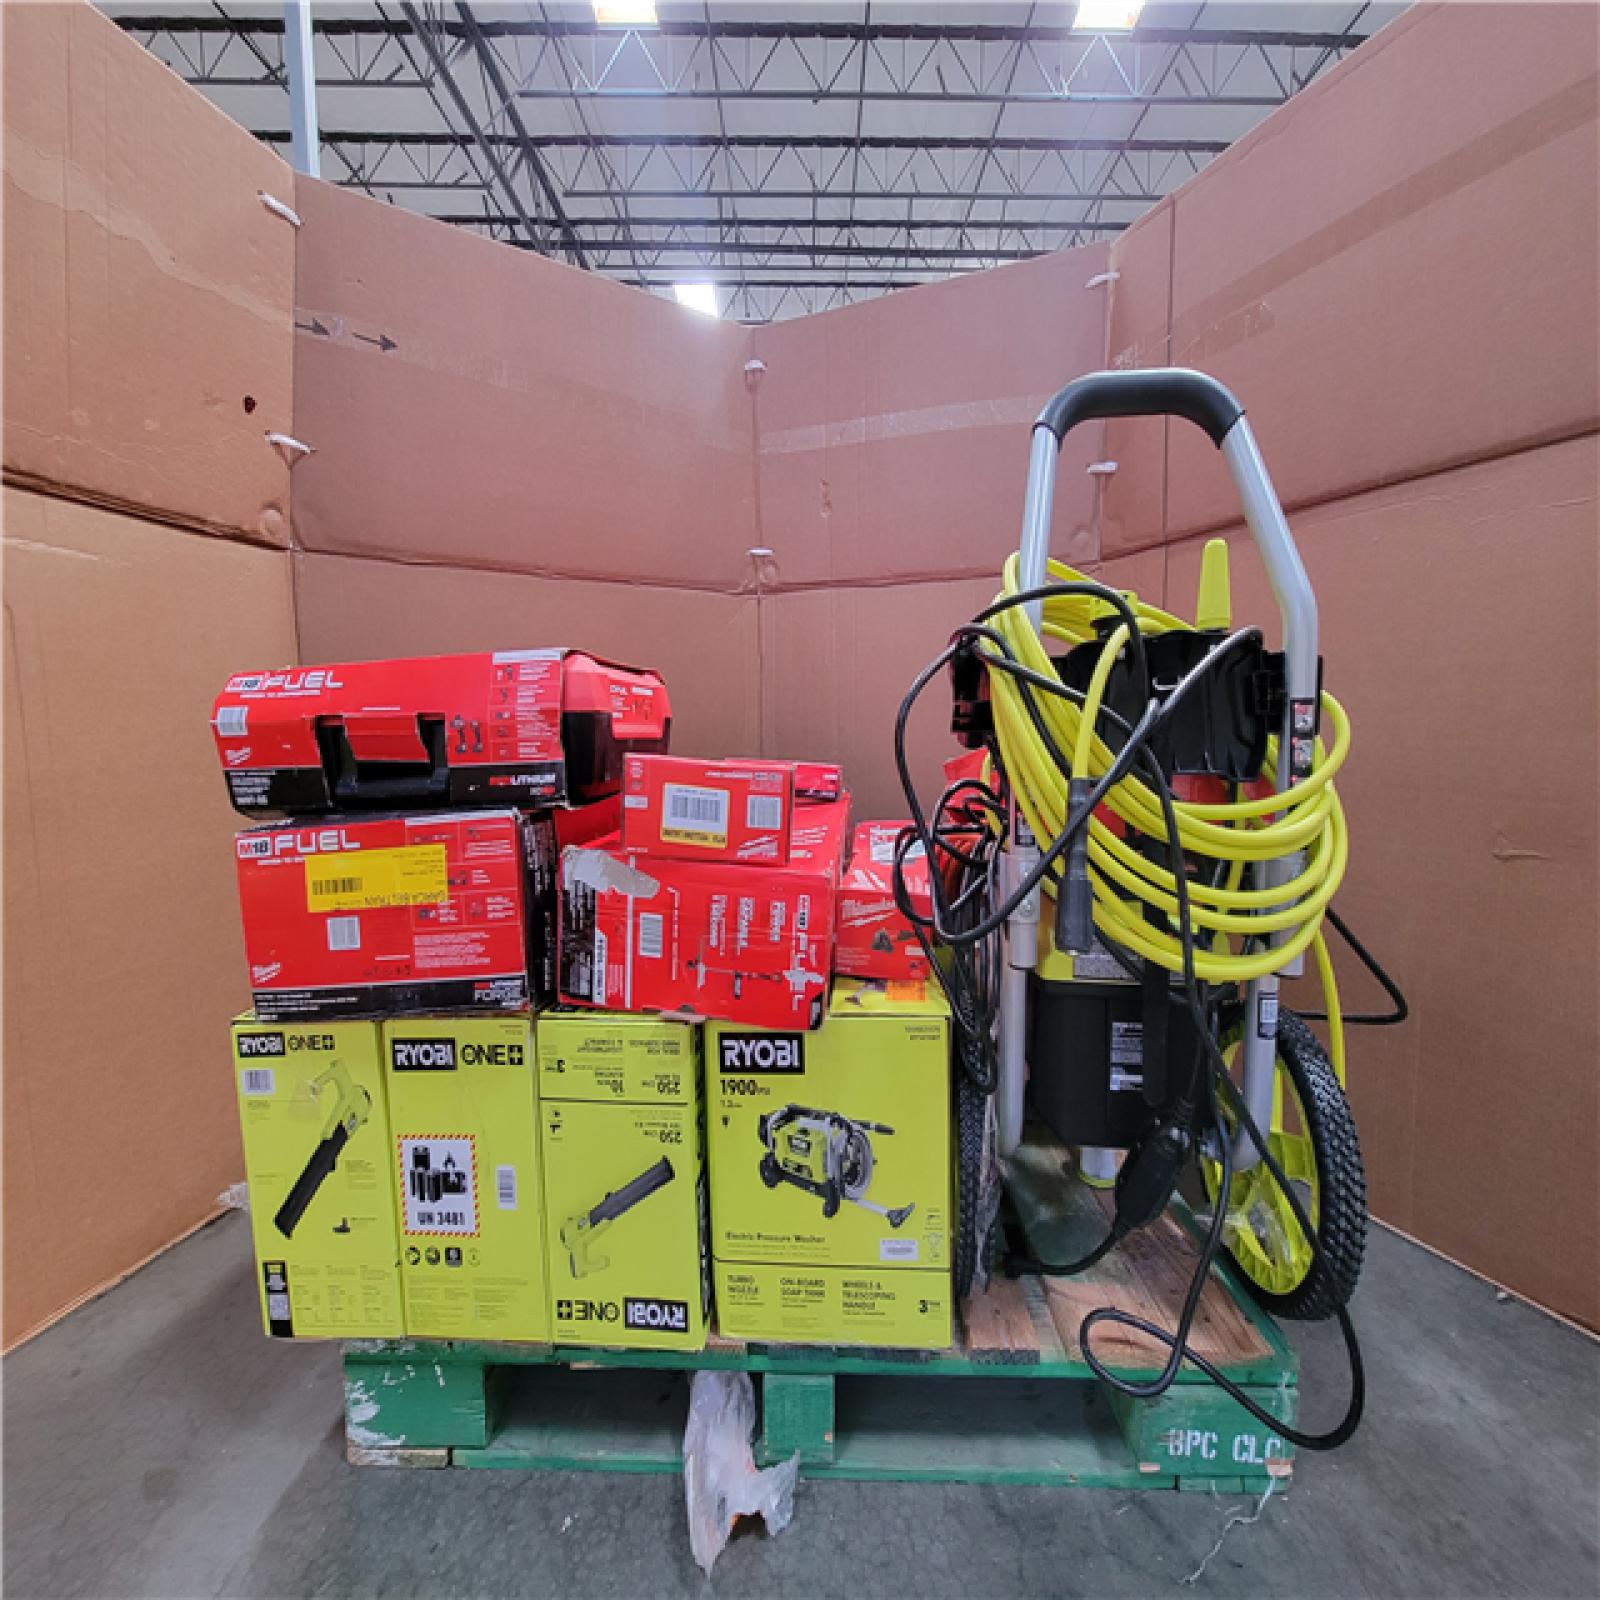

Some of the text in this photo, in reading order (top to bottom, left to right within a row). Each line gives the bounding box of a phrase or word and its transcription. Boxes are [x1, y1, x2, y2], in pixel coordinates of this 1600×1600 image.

[264, 670, 343, 690] FUEL
[274, 829, 361, 851] FUEL
[394, 1043, 454, 1067] RYOBI
[721, 1038, 801, 1069] RYOBI
[416, 1211, 465, 1227] UN 3481
[626, 1301, 686, 1328] RYOBI
